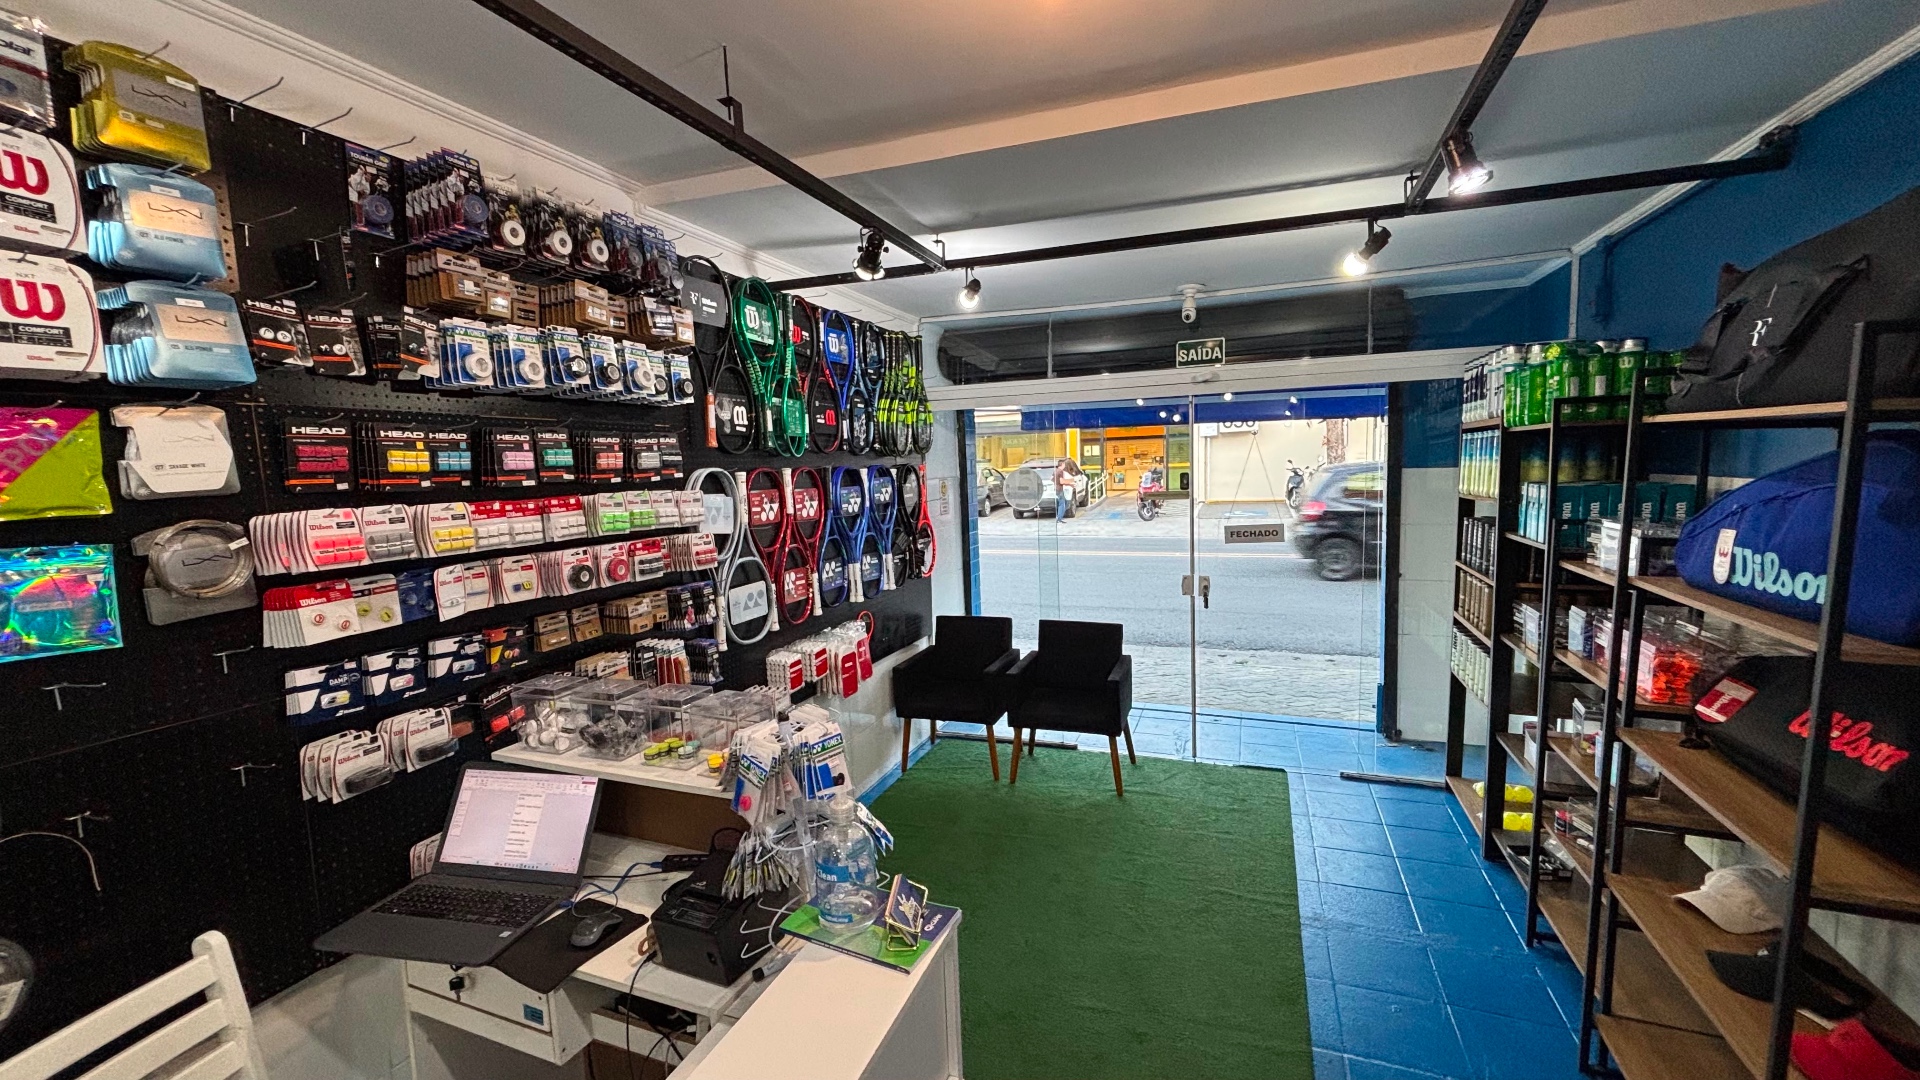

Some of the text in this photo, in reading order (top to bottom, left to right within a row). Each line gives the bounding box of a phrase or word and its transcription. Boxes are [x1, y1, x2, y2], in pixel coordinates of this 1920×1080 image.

[5, 194, 49, 209] COMFORT
[247, 299, 297, 315] HEAD
[307, 314, 352, 324] HEAD
[403, 315, 437, 331] HEAD
[18, 325, 64, 335] COMFORT
[376, 323, 402, 331] HEA
[467, 328, 486, 338] YONEX
[519, 334, 537, 343] YONEX
[1178, 346, 1222, 362] SAÍDA
[291, 426, 347, 435] HEAD
[379, 430, 425, 439] HEAD
[429, 432, 468, 440] HEAD
[537, 432, 567, 440] HEAD
[308, 523, 334, 531] Wilson
[364, 519, 387, 527] Wilson
[1229, 529, 1279, 538] FECHADO
[299, 597, 327, 607] Wilson
[329, 676, 348, 686] DAMP
[409, 726, 429, 737] Wilson
[823, 734, 844, 749] YONEX
[337, 753, 361, 765] Wilson
[749, 760, 768, 780] YONEX
[817, 868, 838, 882] Clean
